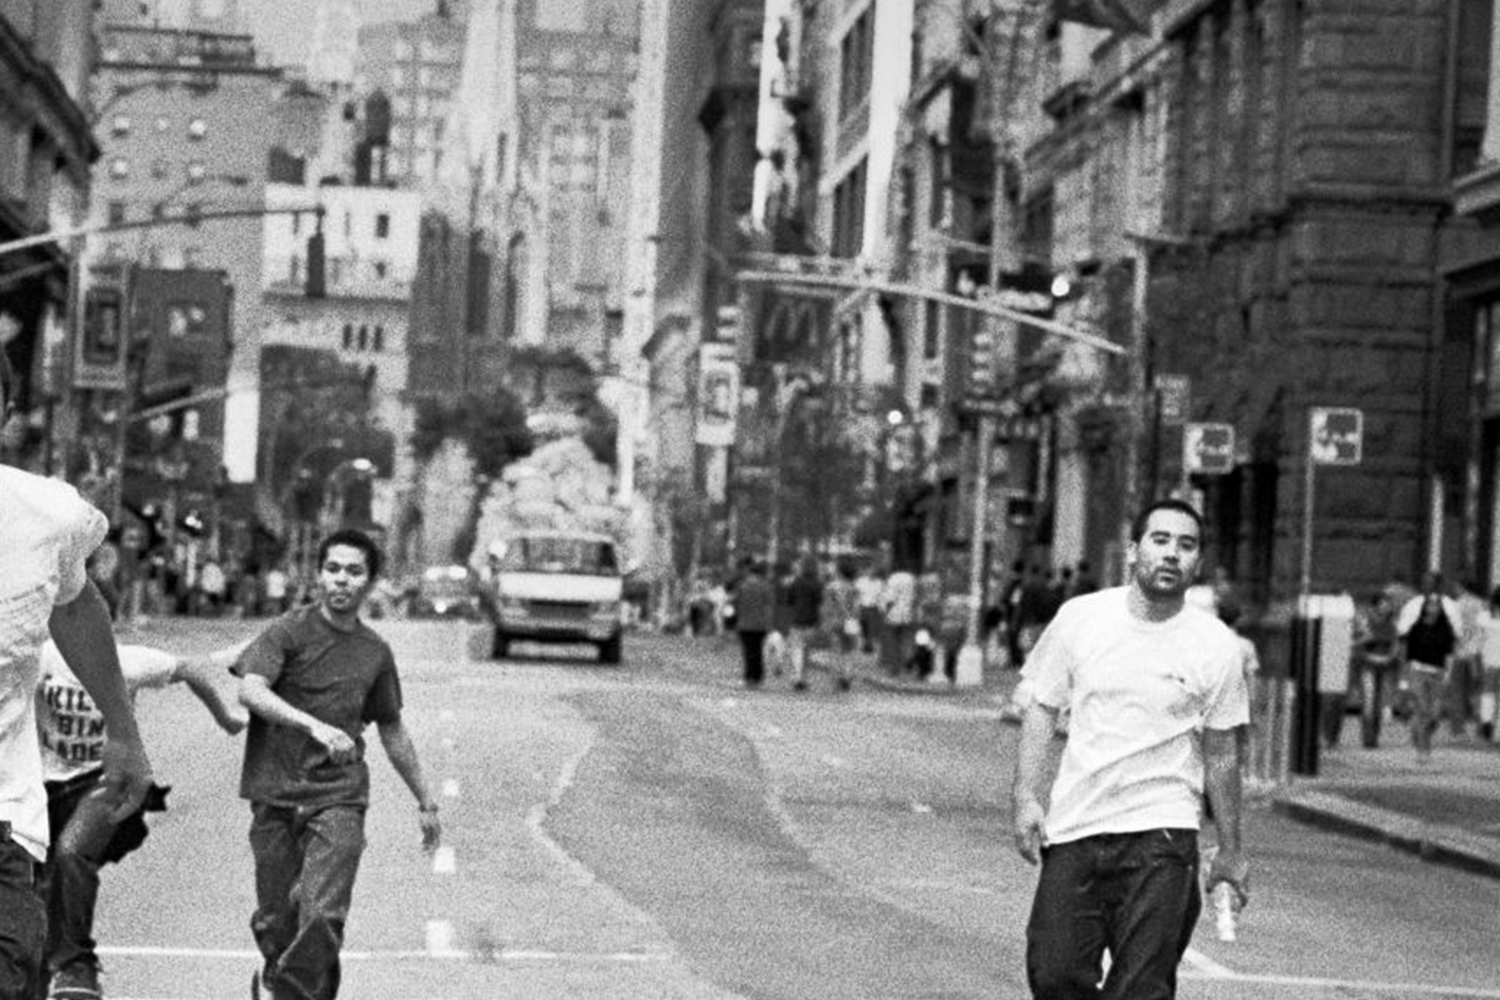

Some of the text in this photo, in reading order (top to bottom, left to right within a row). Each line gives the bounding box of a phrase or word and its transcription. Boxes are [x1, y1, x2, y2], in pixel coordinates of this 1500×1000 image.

[47, 686, 92, 711] KIL
[59, 715, 105, 737] BIN
[42, 731, 104, 761] LADE
